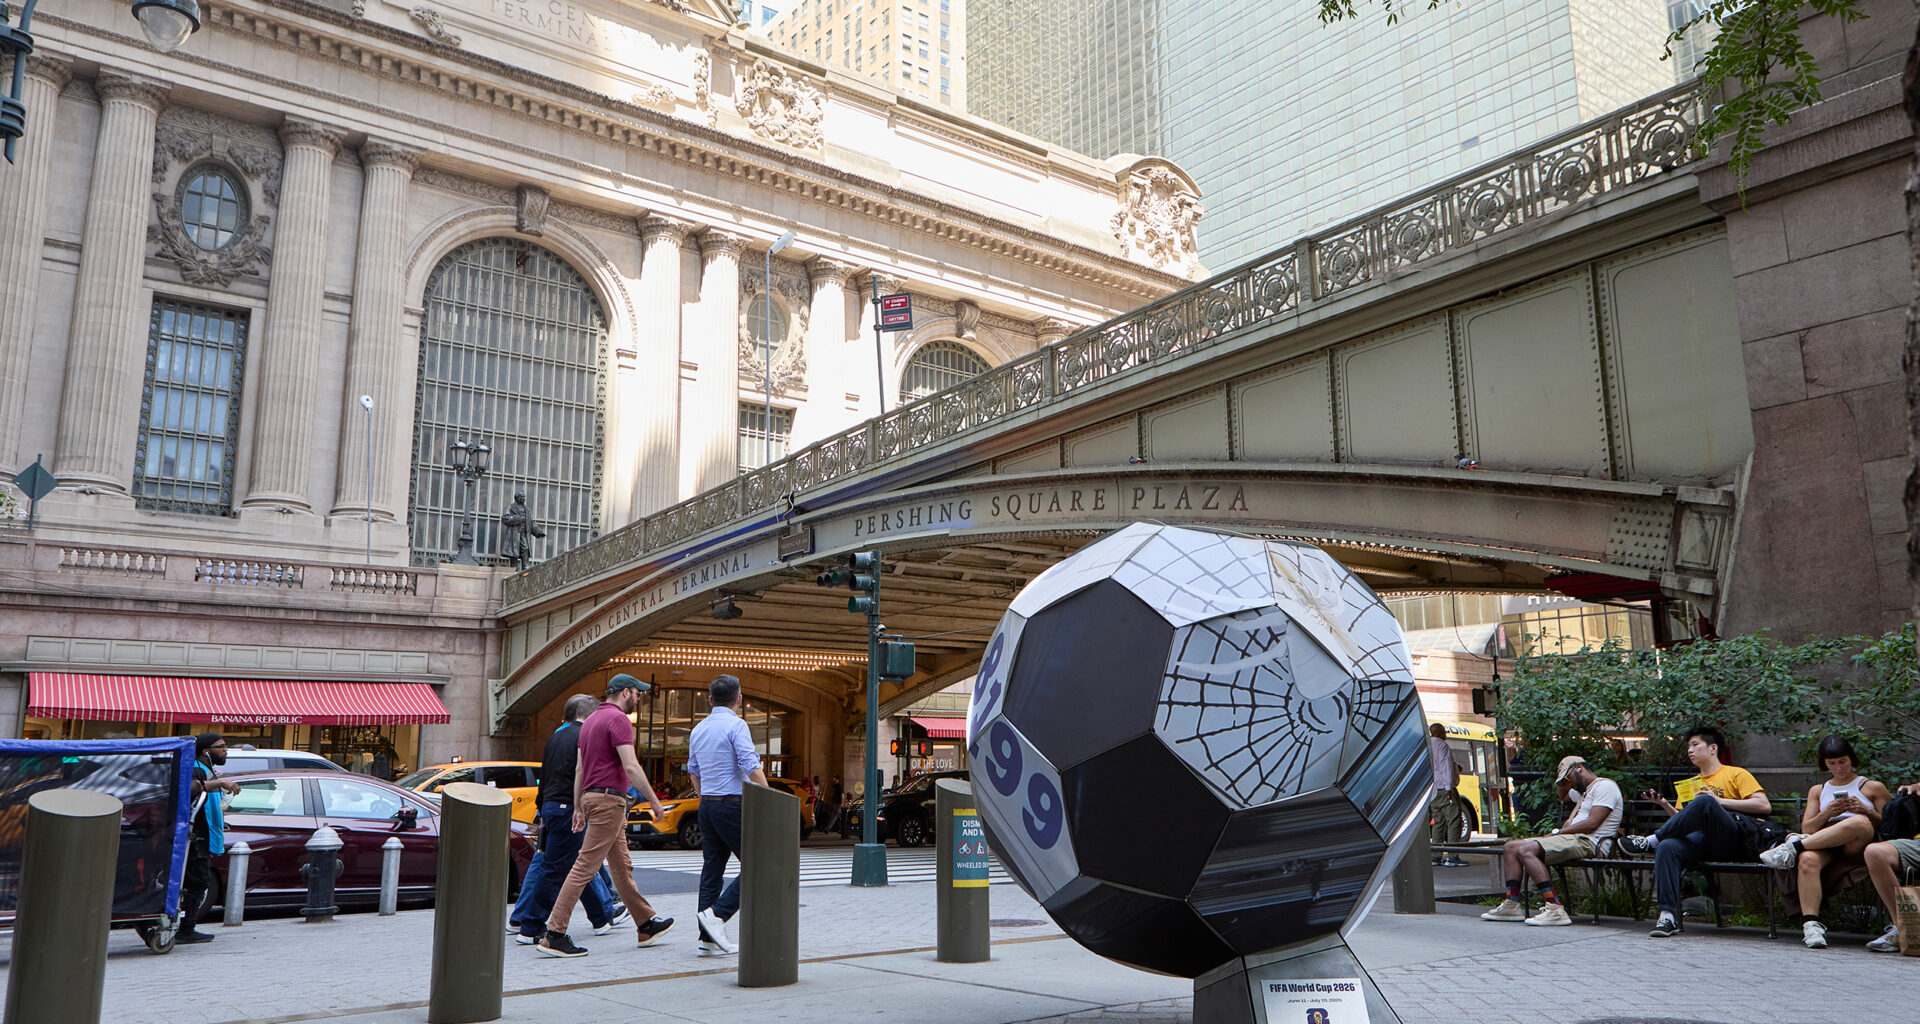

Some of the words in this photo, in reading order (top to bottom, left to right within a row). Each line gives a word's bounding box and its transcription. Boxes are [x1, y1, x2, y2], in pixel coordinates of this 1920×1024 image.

[854, 500, 973, 537] PERSHING
[991, 487, 1106, 521] SQUARE
[1131, 485, 1249, 512] PLAZA
[564, 623, 602, 658] GRAND
[608, 588, 665, 629] CENTRAL
[672, 552, 750, 595] TERMINAL
[211, 715, 254, 723] BANANA
[255, 715, 303, 724] REPUBLIC
[922, 759, 935, 769] THE
[936, 759, 953, 769] LOVE
[962, 819, 981, 828] DISM
[962, 828, 979, 837] AND
[1269, 983, 1289, 993] FIFA
[1288, 983, 1315, 993] World
[1316, 982, 1333, 994] Cup
[1333, 982, 1356, 992] 2026
